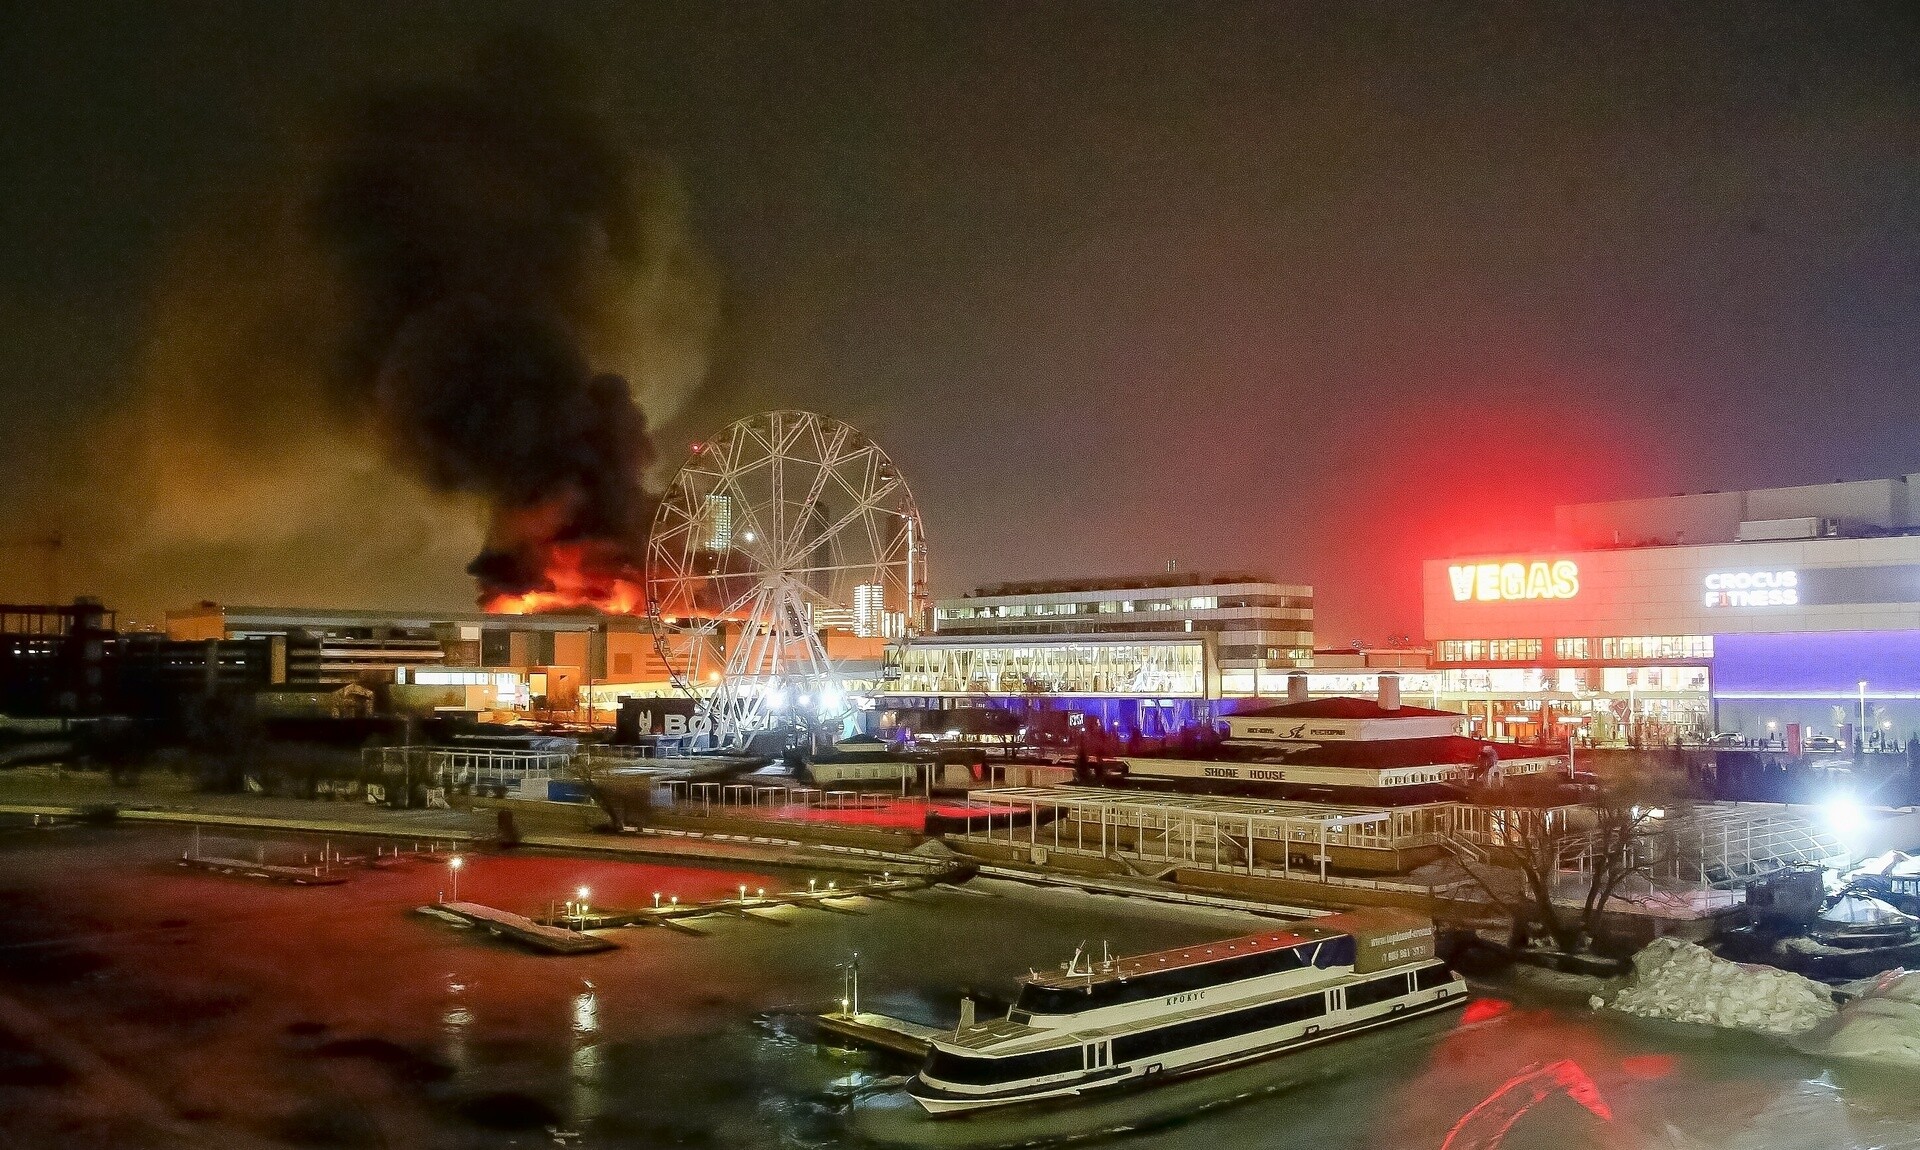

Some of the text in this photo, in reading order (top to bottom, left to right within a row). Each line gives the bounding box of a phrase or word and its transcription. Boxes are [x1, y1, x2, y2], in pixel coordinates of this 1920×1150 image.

[1448, 560, 1579, 601] VEGAS
[1705, 571, 1797, 589] CROCUS
[1204, 767, 1286, 780] SHORE HOUSE
